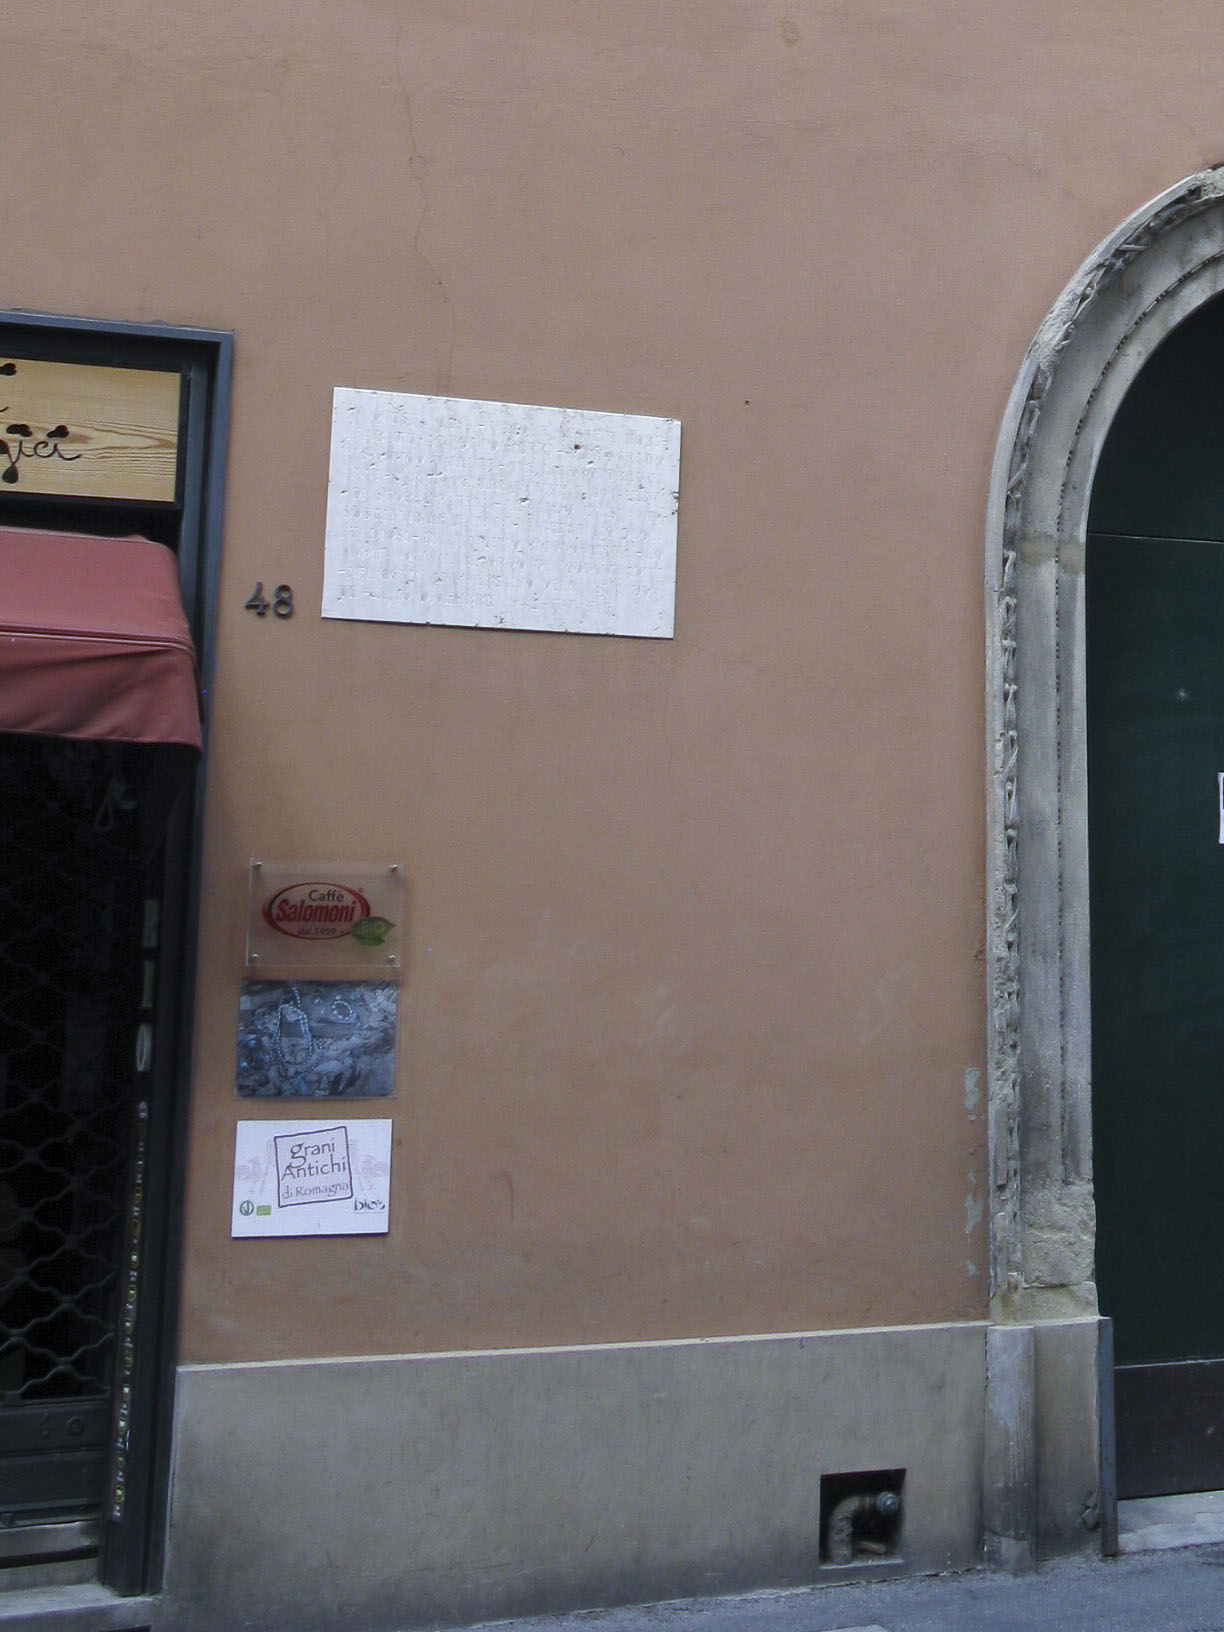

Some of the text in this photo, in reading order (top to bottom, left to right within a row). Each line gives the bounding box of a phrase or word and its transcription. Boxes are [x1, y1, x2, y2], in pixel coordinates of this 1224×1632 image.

[244, 581, 293, 619] 48
[308, 889, 344, 902] Caffè
[276, 899, 357, 923] Salomoni
[287, 1137, 336, 1169] grani
[281, 1154, 347, 1180] Antichi
[282, 1182, 349, 1199] di Romagna
